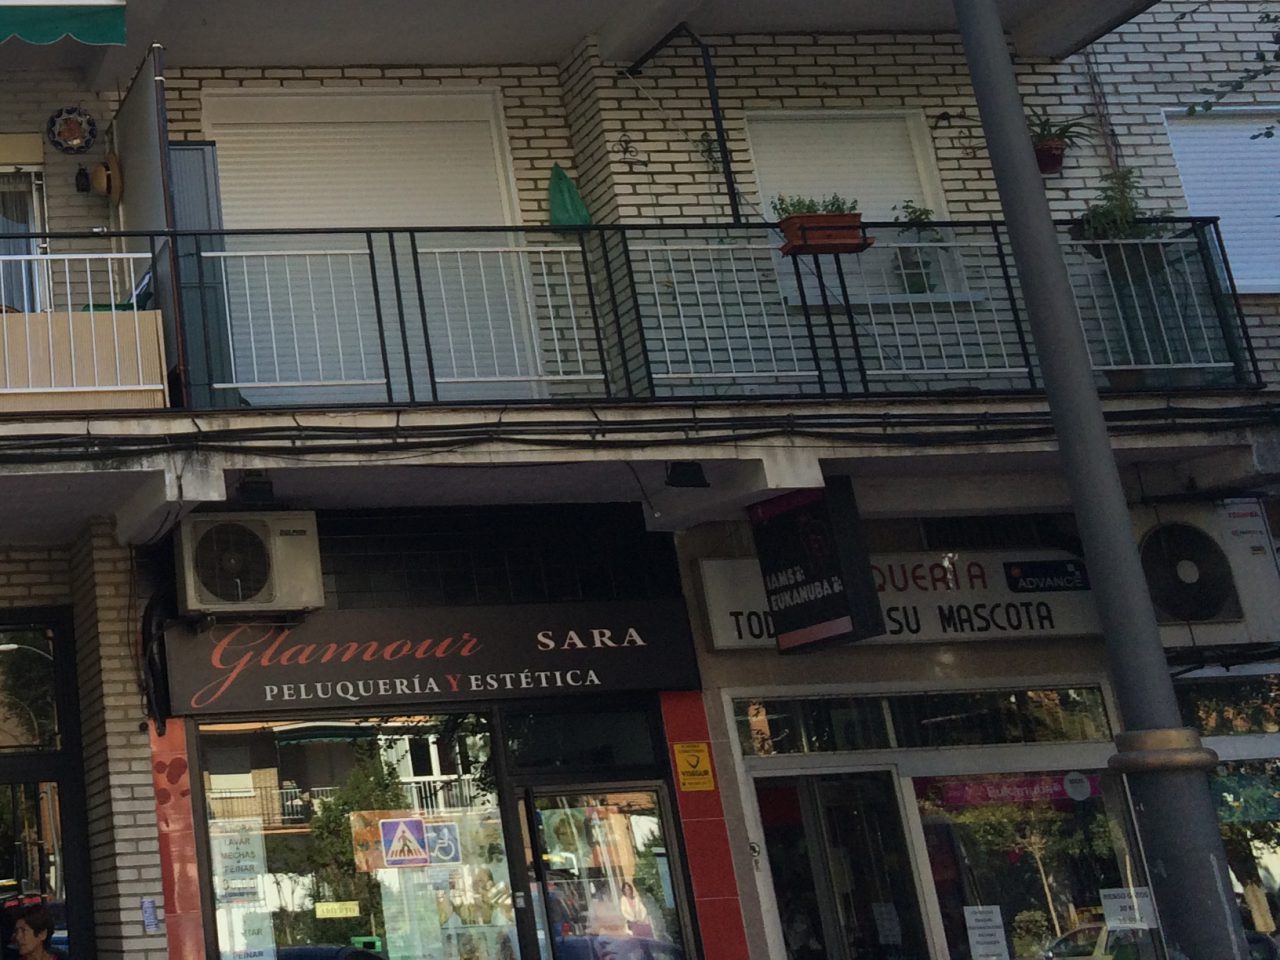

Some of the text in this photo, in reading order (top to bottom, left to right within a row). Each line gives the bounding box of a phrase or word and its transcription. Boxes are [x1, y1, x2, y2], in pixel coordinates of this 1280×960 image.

[766, 568, 796, 590] IAMS
[771, 579, 832, 611] EUKANUBA
[1018, 575, 1084, 589] ADVANCE
[886, 604, 921, 636] SU
[938, 601, 1055, 633] MASCOTA
[536, 627, 647, 651] SARA
[191, 624, 483, 708] Glamour
[264, 668, 602, 701] PELUQUERÍA Y ESTÉTICA
